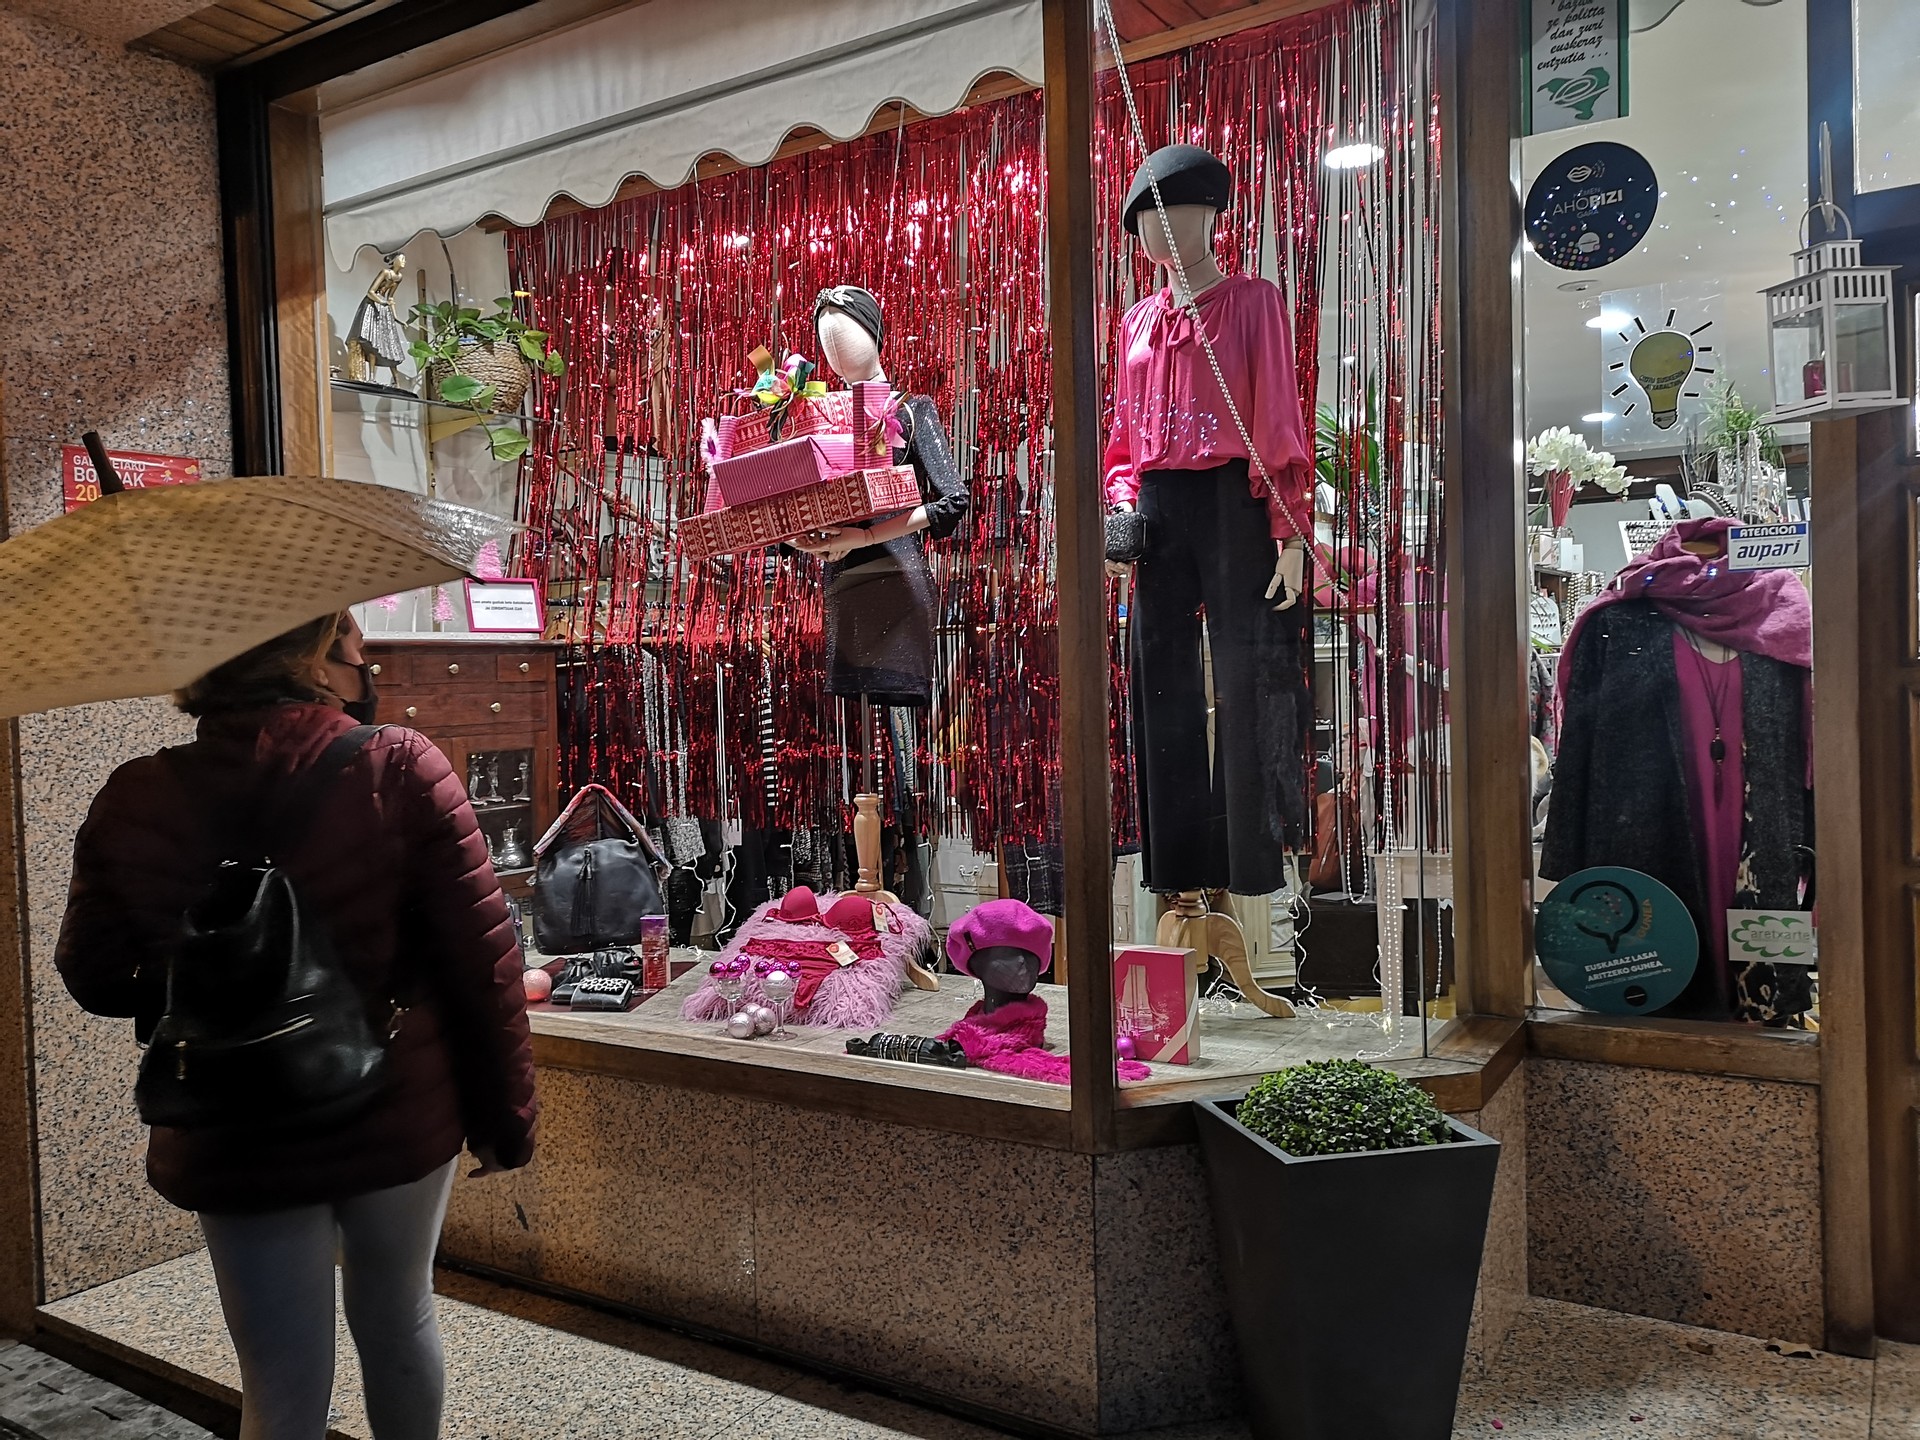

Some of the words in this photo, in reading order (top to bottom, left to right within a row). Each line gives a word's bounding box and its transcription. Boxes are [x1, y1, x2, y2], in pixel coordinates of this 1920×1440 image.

[1546, 17, 1560, 33] ze
[1550, 27, 1574, 40] dan
[1574, 18, 1605, 38] zuri
[1550, 35, 1603, 54] euskeraz
[1537, 51, 1586, 71] entzutia
[1552, 188, 1623, 216] AHOBIZI
[73, 466, 145, 488] BOAK
[1739, 525, 1797, 538] ATENCION
[1737, 539, 1801, 562] aupari
[1751, 930, 1810, 940] aretxarte
[1584, 956, 1631, 972] EUSKARAZ
[1631, 950, 1658, 962] LASAI
[1588, 967, 1630, 982] ARITZEKO
[1630, 960, 1663, 972] GUNEA
